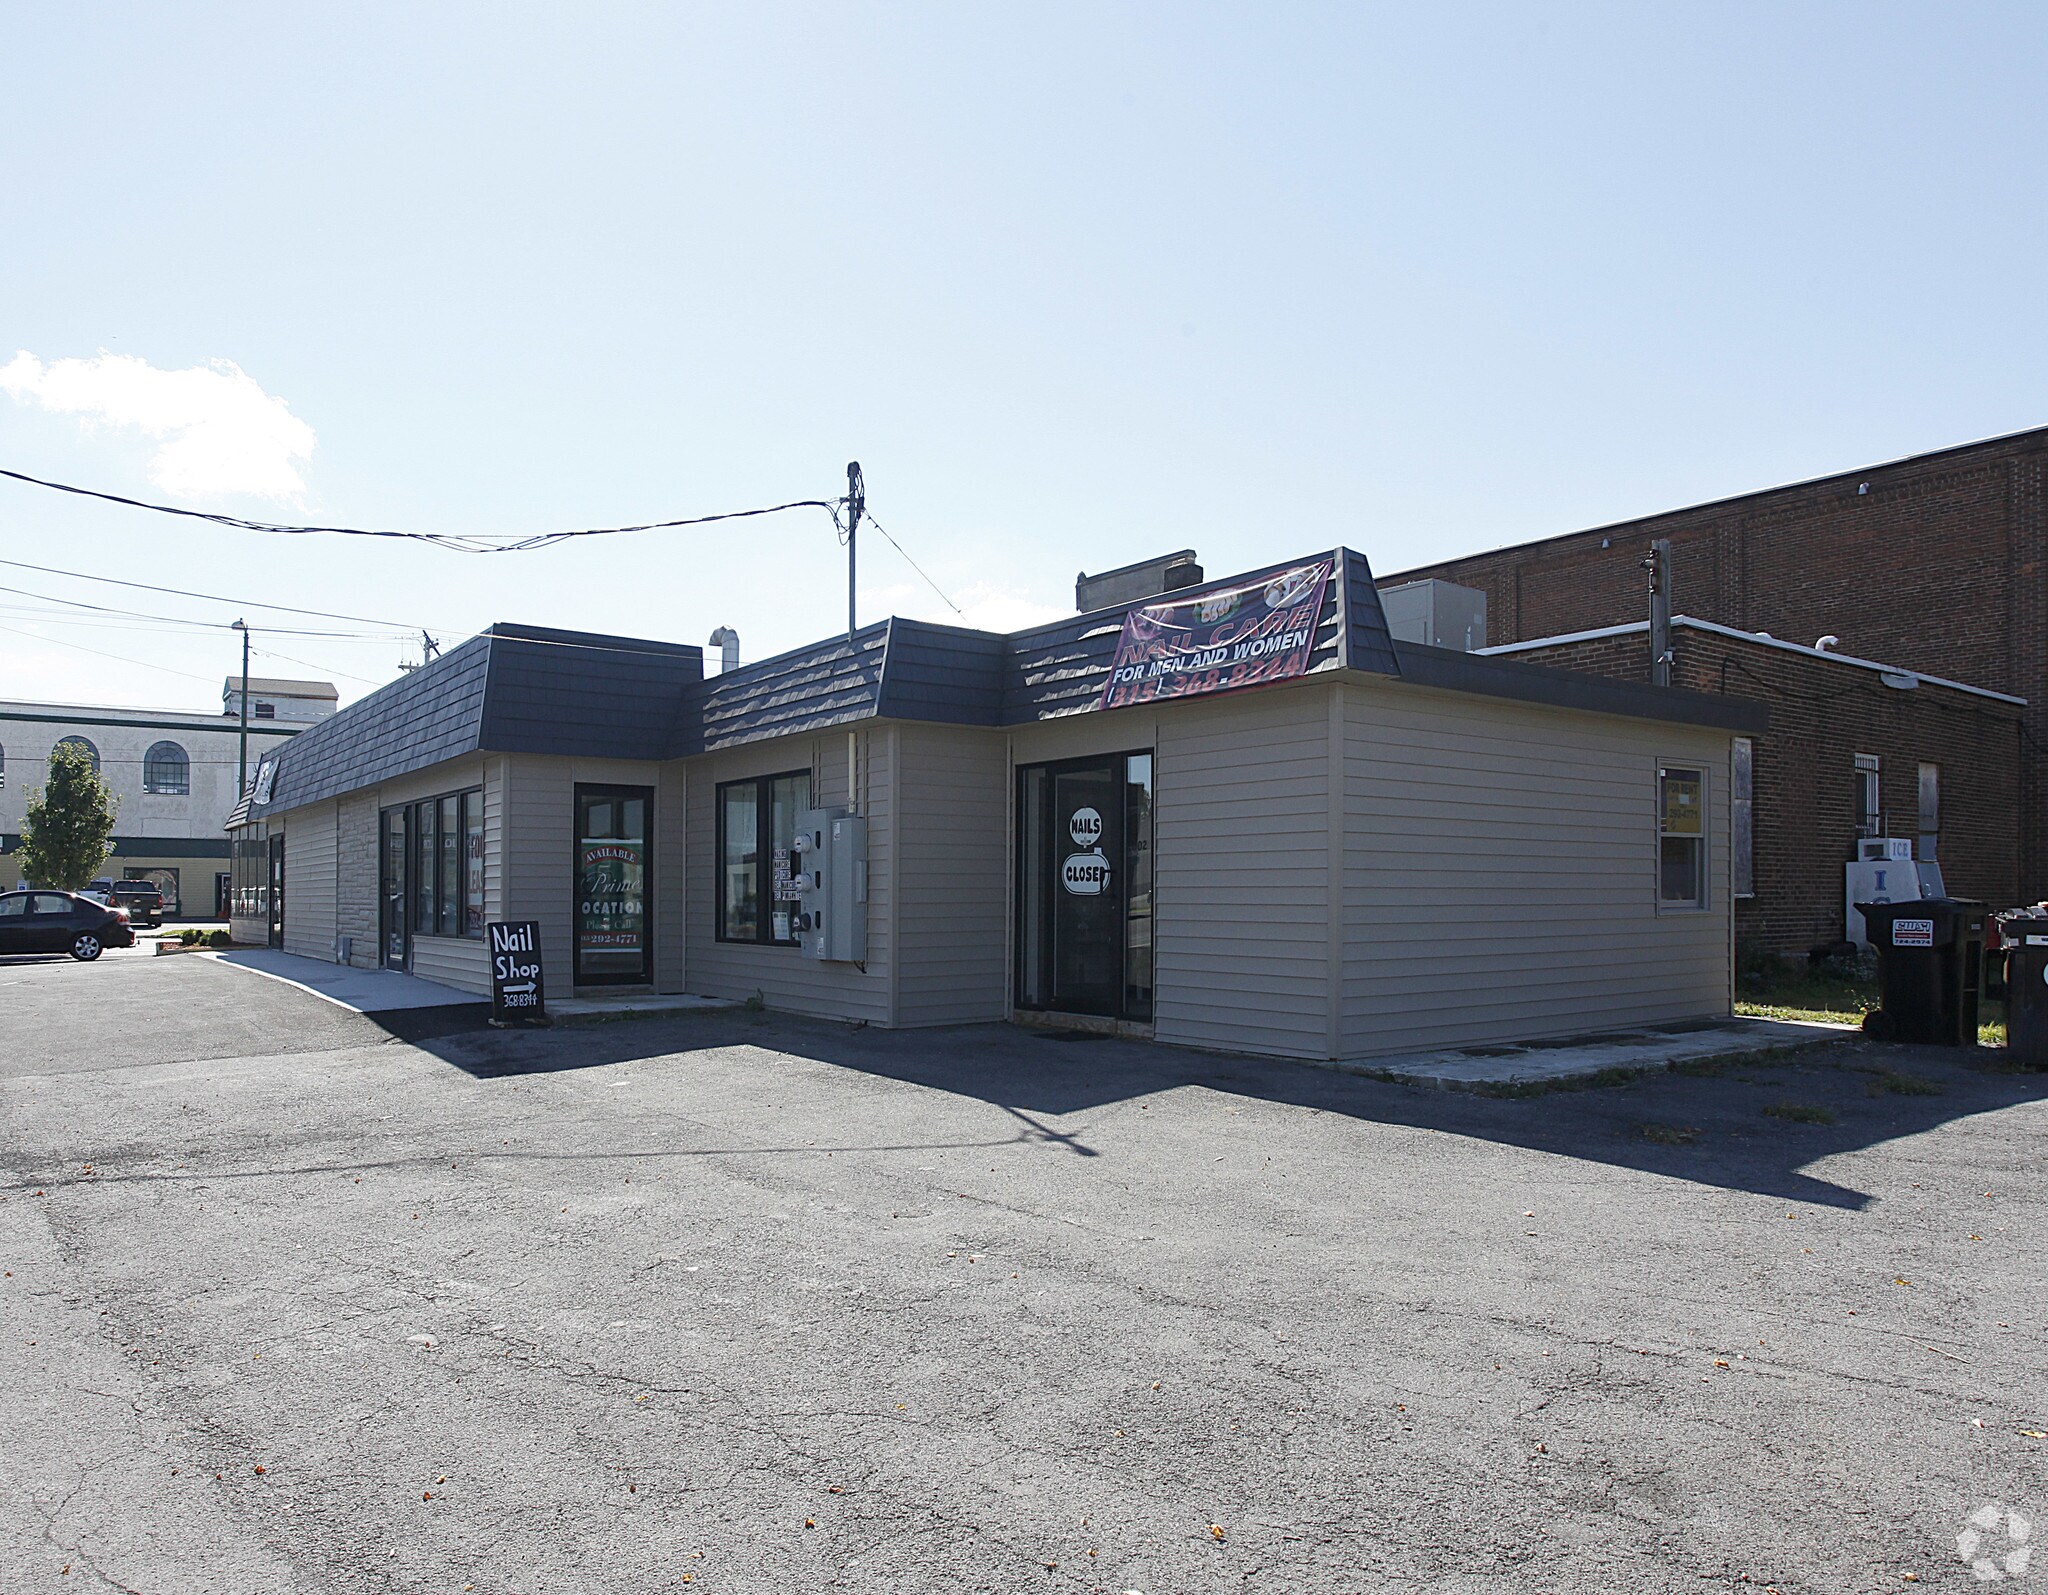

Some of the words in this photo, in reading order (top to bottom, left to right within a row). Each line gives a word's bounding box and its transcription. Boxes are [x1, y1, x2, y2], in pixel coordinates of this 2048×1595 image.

[1118, 633, 1198, 667] NAIL
[1209, 603, 1315, 647] CARE
[1112, 664, 1145, 684] FOR
[1148, 656, 1186, 678] MEN
[1190, 648, 1228, 668] AND
[1234, 630, 1309, 660] WOMEN
[1071, 818, 1100, 834] NAILS
[587, 848, 636, 863] AVAILABLE
[1892, 842, 1908, 857] ICE
[582, 872, 642, 893] Prime
[1066, 866, 1105, 882] CLOSED
[492, 924, 533, 952] Nail
[496, 956, 540, 980] Shop
